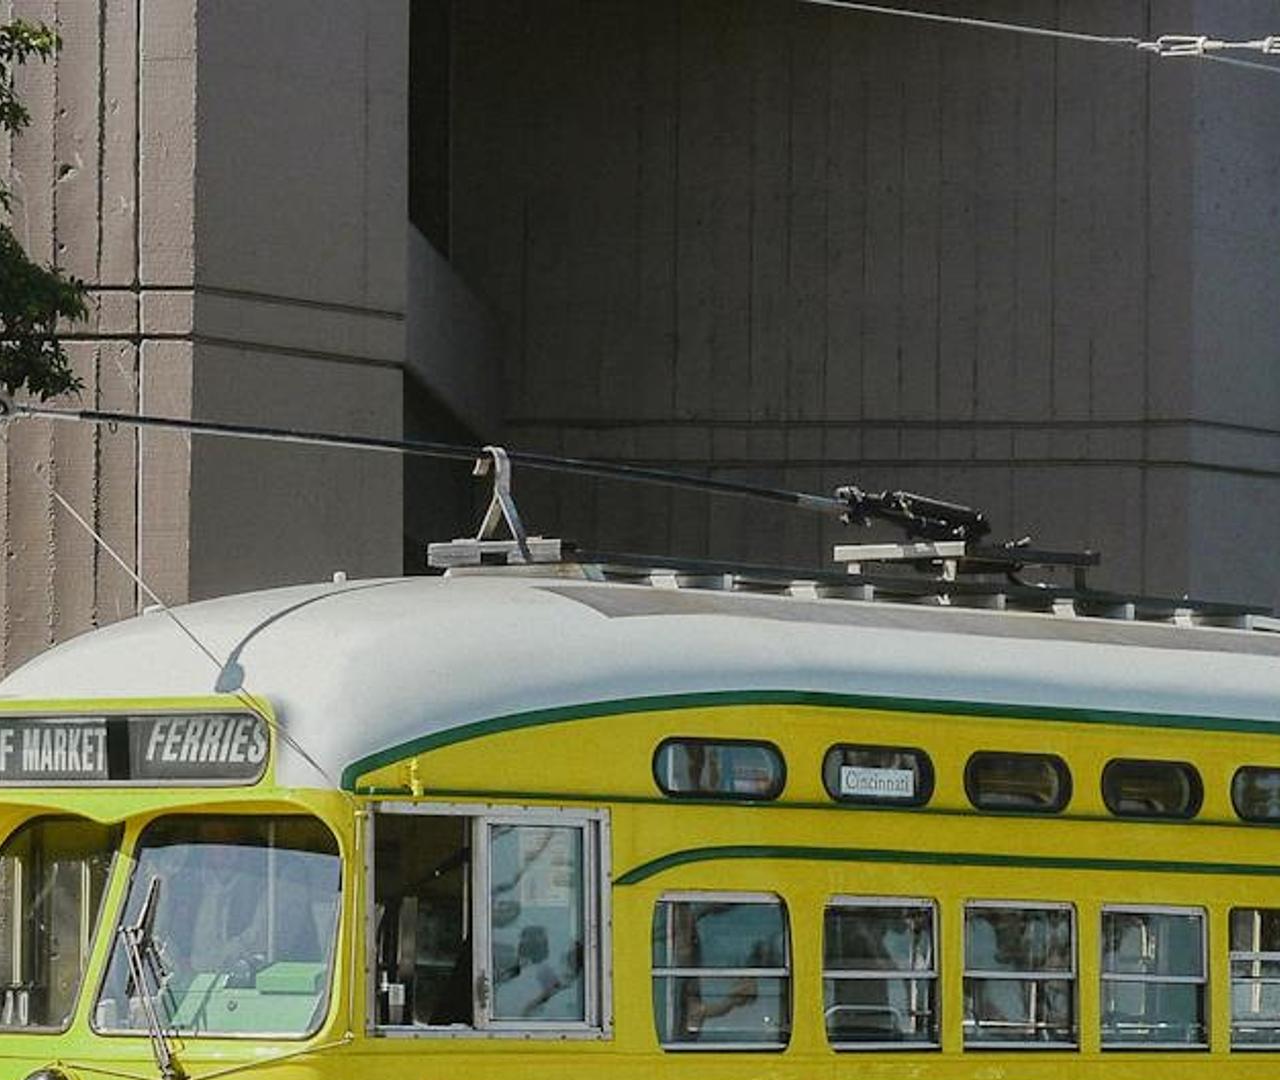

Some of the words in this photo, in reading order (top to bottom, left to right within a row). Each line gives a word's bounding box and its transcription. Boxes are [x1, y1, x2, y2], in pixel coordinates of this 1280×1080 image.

[23, 727, 107, 772] MARKET
[146, 717, 268, 764] FERRIES
[846, 770, 910, 793] Cincinnati
